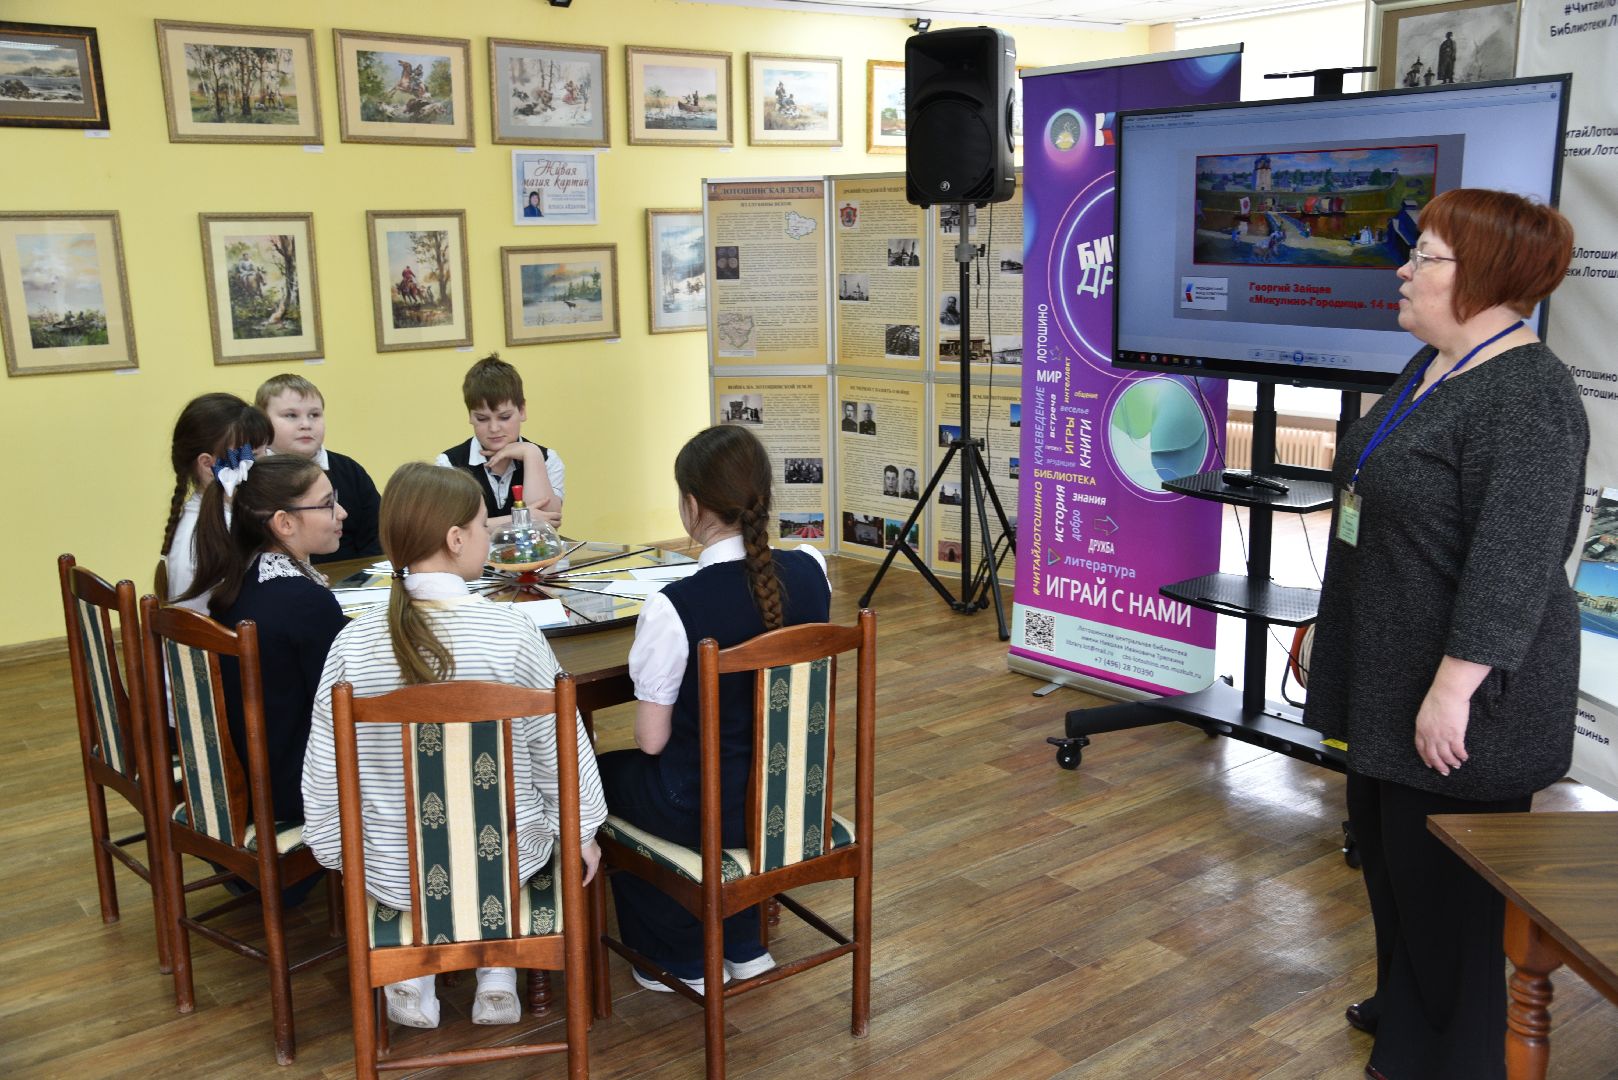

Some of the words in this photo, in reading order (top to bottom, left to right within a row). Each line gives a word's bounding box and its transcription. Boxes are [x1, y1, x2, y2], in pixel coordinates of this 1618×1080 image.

[1550, 18, 1607, 37] Библиотеки
[1608, 14, 1618, 27] Л
[534, 159, 577, 176] Живая
[523, 178, 550, 187] магия
[553, 175, 589, 193] картин
[1249, 282, 1290, 294] Георгий
[1293, 283, 1332, 296] Зайцев
[1371, 300, 1385, 310] 14
[1036, 303, 1048, 363] ЛОТОШИНО
[1036, 369, 1062, 384] МИР
[1060, 405, 1089, 415] веселье
[1034, 386, 1045, 466] КРАЕВЕДЕНИЕ
[1065, 417, 1075, 455] ИГРЫ
[1079, 419, 1092, 469] КНИГИ
[1033, 469, 1097, 486] БИБЛИОТЕКА
[1072, 492, 1107, 506] знания
[1055, 484, 1068, 543] ИСТОРИЯ
[1070, 509, 1083, 542] добро
[1031, 481, 1042, 596] #ЧИТАЙЛОТОШИНО
[1088, 538, 1115, 555] ДРУЖБА
[1064, 554, 1136, 579] литература
[1046, 574, 1107, 609] ИГРАЙ
[1111, 589, 1124, 613] С
[1129, 591, 1191, 628] НАМИ
[1152, 643, 1188, 657] библиотека
[1104, 658, 1121, 670] (496)
[1122, 663, 1131, 671] 28
[1132, 666, 1154, 678] 70390
[1575, 708, 1597, 722] ино
